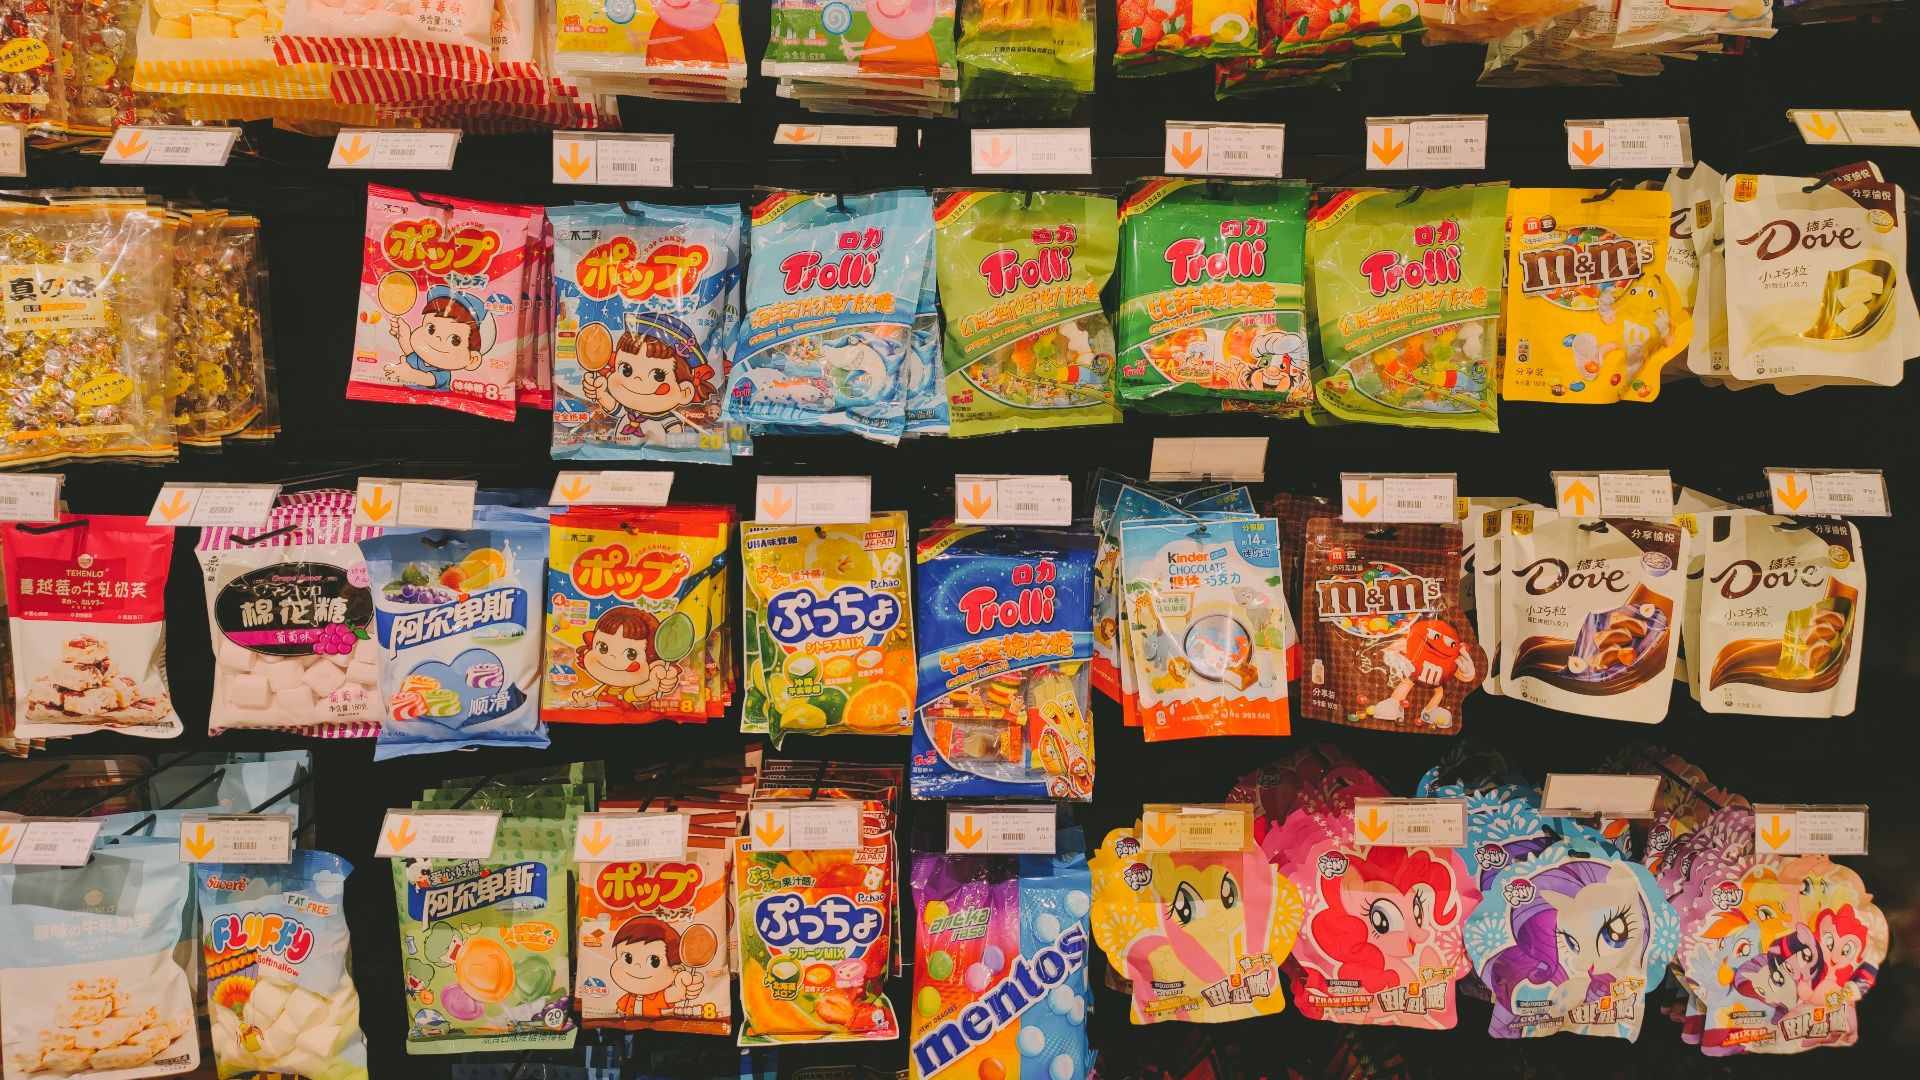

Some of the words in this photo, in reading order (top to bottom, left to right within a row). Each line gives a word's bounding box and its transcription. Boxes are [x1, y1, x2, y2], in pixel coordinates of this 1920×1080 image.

[1740, 177, 1755, 191] 新
[1852, 188, 1893, 201] 分享愉悦
[1031, 224, 1076, 246] 口力
[1220, 217, 1267, 238] 口力
[1413, 220, 1460, 247] 口力
[1807, 217, 1835, 232] 德芙
[389, 225, 496, 270] ポップ
[838, 227, 884, 250] 口力
[1736, 219, 1861, 261] Dove
[583, 243, 703, 297] ポップ
[979, 246, 1073, 297] Trolli
[1164, 238, 1267, 285] Trolli
[1360, 246, 1460, 297] Trolli
[780, 251, 880, 294] Trolli
[1759, 264, 1809, 283] 小巧粒
[553, 411, 590, 423] 安全纸棒
[865, 531, 884, 540] MADE
[1631, 528, 1676, 543] 分享愉悦
[1815, 524, 1848, 536] 分享愉悦
[864, 538, 895, 548] JAPAN
[66, 569, 104, 578] TEHENLO
[578, 549, 686, 597] ポップ
[1012, 560, 1058, 586] 口力
[1576, 558, 1606, 571] 德芙
[1768, 556, 1797, 571] 德芙
[20, 578, 148, 600] 蔓越莓の牛轧奶芙
[1204, 572, 1241, 587] 巧克力
[1511, 557, 1630, 602] Dove
[1710, 559, 1825, 600] Dove
[239, 597, 349, 628] 棉花糖
[772, 590, 894, 638] ぷっちょ
[959, 585, 1057, 635] Trolli
[1525, 605, 1567, 617] 小巧粒
[1724, 605, 1770, 620] 小巧粒
[390, 587, 516, 660] 阿尔卑斯
[275, 630, 313, 644] 葡萄味
[940, 629, 1075, 675] 午餐橡皮糖
[328, 691, 368, 704] 葡萄味
[468, 690, 511, 717] 顺滑
[1312, 688, 1336, 700] 分享装
[855, 853, 885, 862] JAPAN
[1318, 857, 1349, 878] PONY
[1476, 850, 1508, 867] PONY
[602, 863, 698, 907] ポップ
[1125, 868, 1152, 887] PONY
[421, 863, 536, 932] 阿尔卑斯
[1503, 886, 1535, 903] PONY
[1711, 888, 1744, 907] PONY
[287, 895, 306, 907] FAT
[306, 902, 330, 916] FREE
[655, 907, 696, 920] キャンディ
[761, 897, 878, 940] ぷっちょ
[929, 906, 991, 935] aneka
[212, 914, 314, 964] FLUFFY
[951, 926, 986, 942] rasa
[789, 947, 846, 960] フルーツMIX
[256, 954, 301, 978] Softmallow
[774, 990, 797, 999] メロン
[912, 922, 1088, 1080] mentos
[1308, 995, 1375, 1004] STRAWBERRY
[547, 1009, 562, 1021] 20
[1730, 1029, 1767, 1039] MIXED
